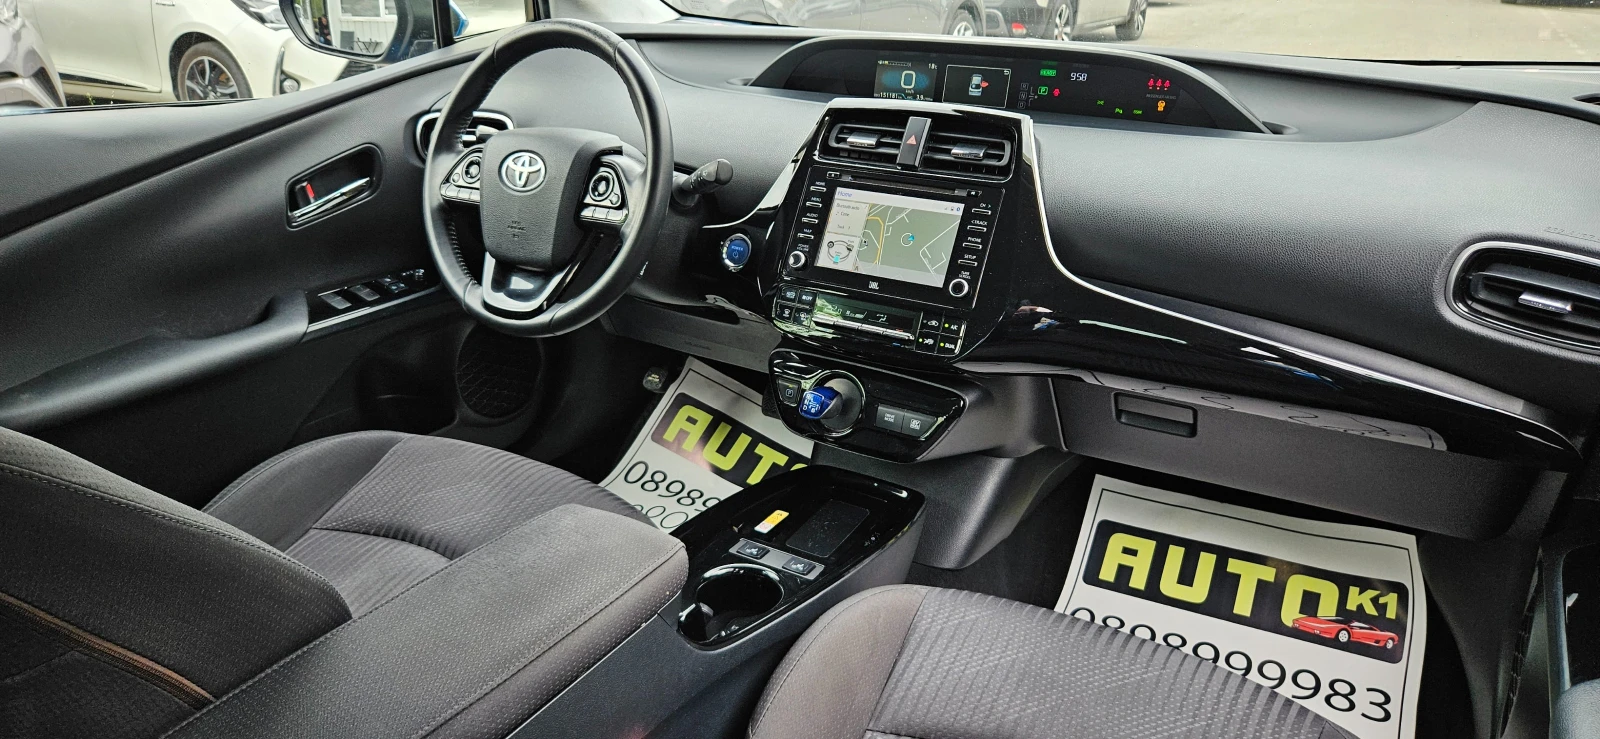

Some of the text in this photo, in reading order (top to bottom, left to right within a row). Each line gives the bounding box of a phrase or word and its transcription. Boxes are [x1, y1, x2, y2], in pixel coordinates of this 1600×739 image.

[900, 70, 916, 89] 0
[837, 190, 853, 198] Home
[868, 281, 880, 290] JBL
[662, 404, 808, 486] AUT
[1098, 532, 1398, 628] AUTO K1
